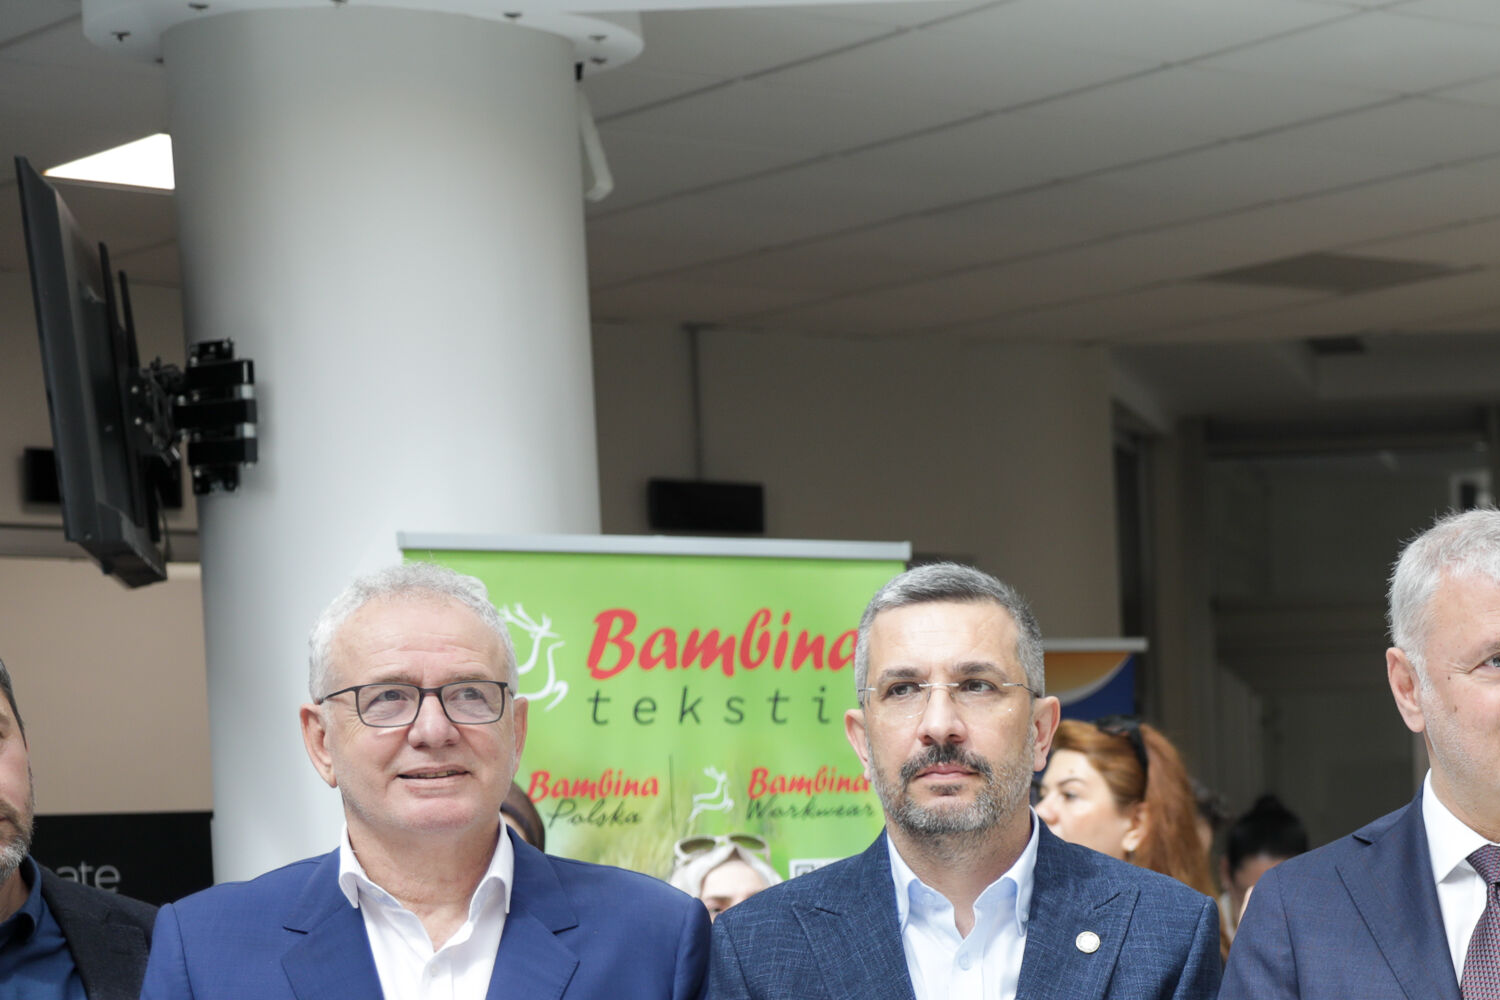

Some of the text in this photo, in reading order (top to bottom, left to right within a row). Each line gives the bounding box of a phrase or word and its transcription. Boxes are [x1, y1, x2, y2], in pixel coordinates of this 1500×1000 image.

[586, 608, 859, 680] Bambina
[587, 685, 831, 726] teksti
[527, 768, 660, 804] Bambina
[748, 765, 870, 800] Bambina
[546, 798, 642, 829] Polska
[746, 794, 874, 820] Workwear
